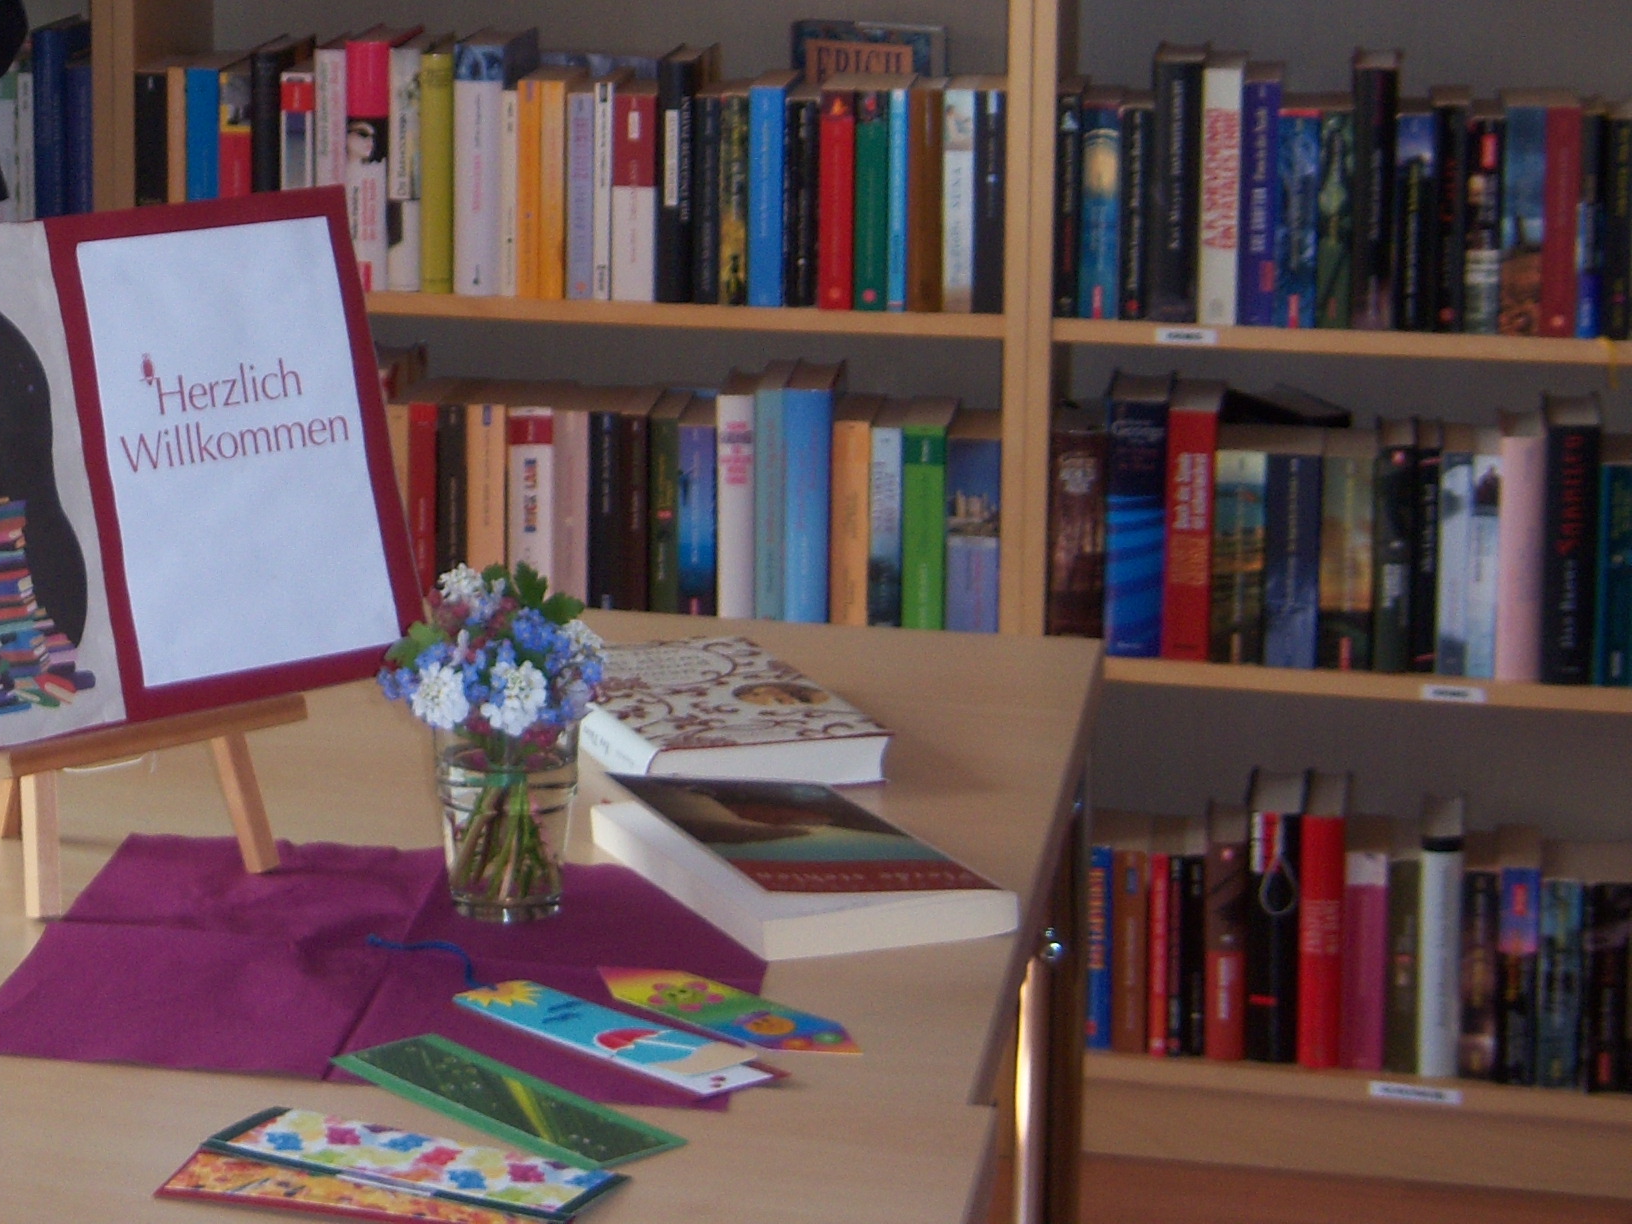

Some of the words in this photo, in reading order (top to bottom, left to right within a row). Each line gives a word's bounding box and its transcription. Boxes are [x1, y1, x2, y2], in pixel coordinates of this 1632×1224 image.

[156, 358, 303, 415] Herzlich
[119, 411, 350, 475] Willkommen
[524, 458, 537, 489] LANE
[524, 494, 537, 533] BRICK
